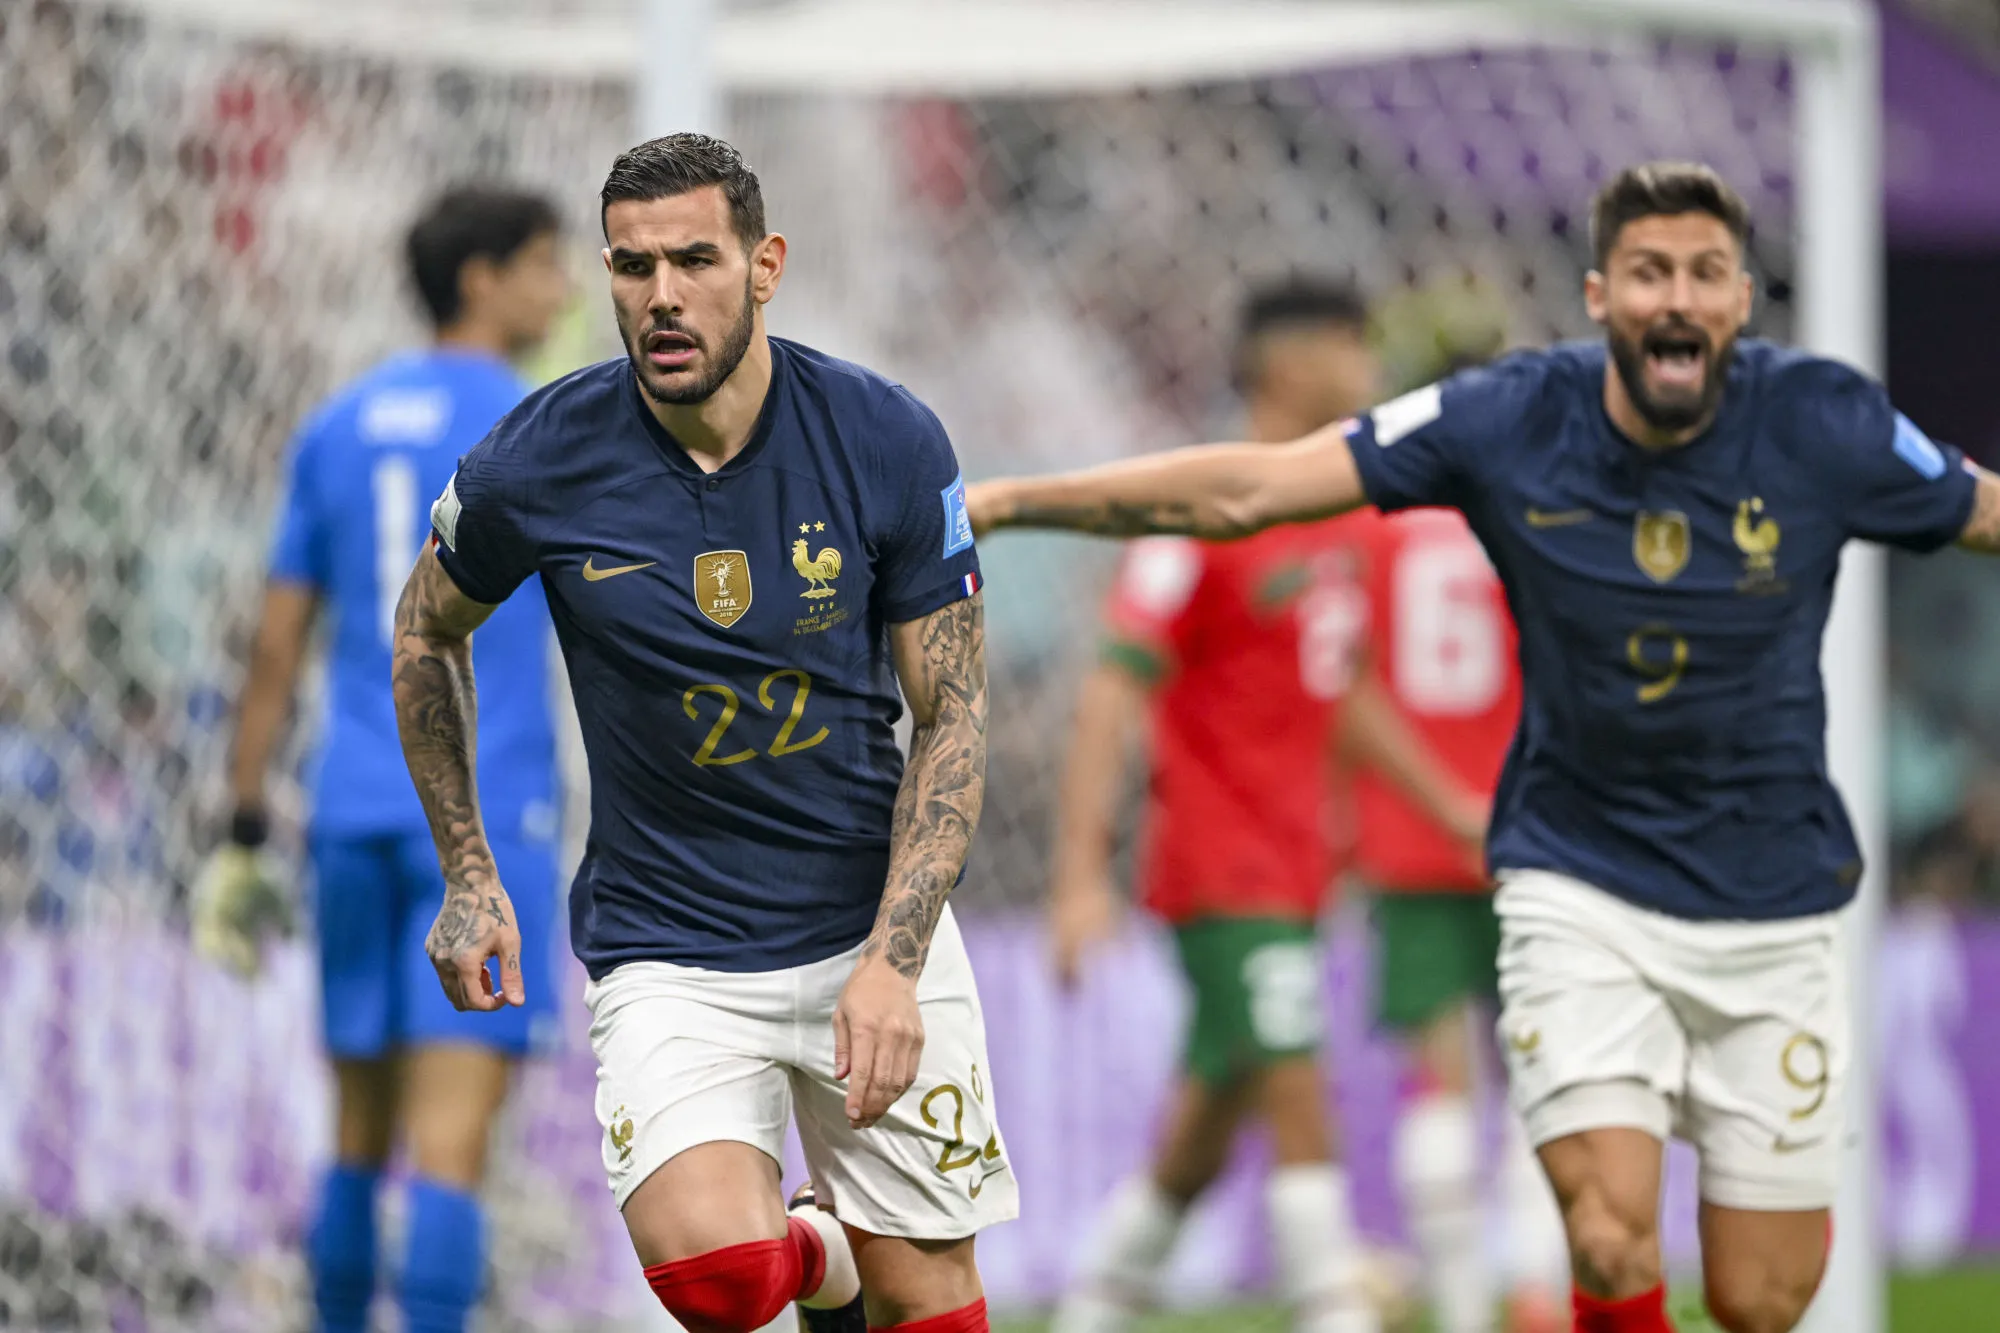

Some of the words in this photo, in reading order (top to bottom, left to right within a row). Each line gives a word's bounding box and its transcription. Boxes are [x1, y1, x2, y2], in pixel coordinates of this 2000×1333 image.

[713, 599, 736, 608] FIFA
[796, 615, 820, 627] FRANCE
[1392, 543, 1507, 715] 6
[1627, 622, 1689, 703] 9
[682, 669, 830, 767] 22
[1781, 1031, 1829, 1122] 9
